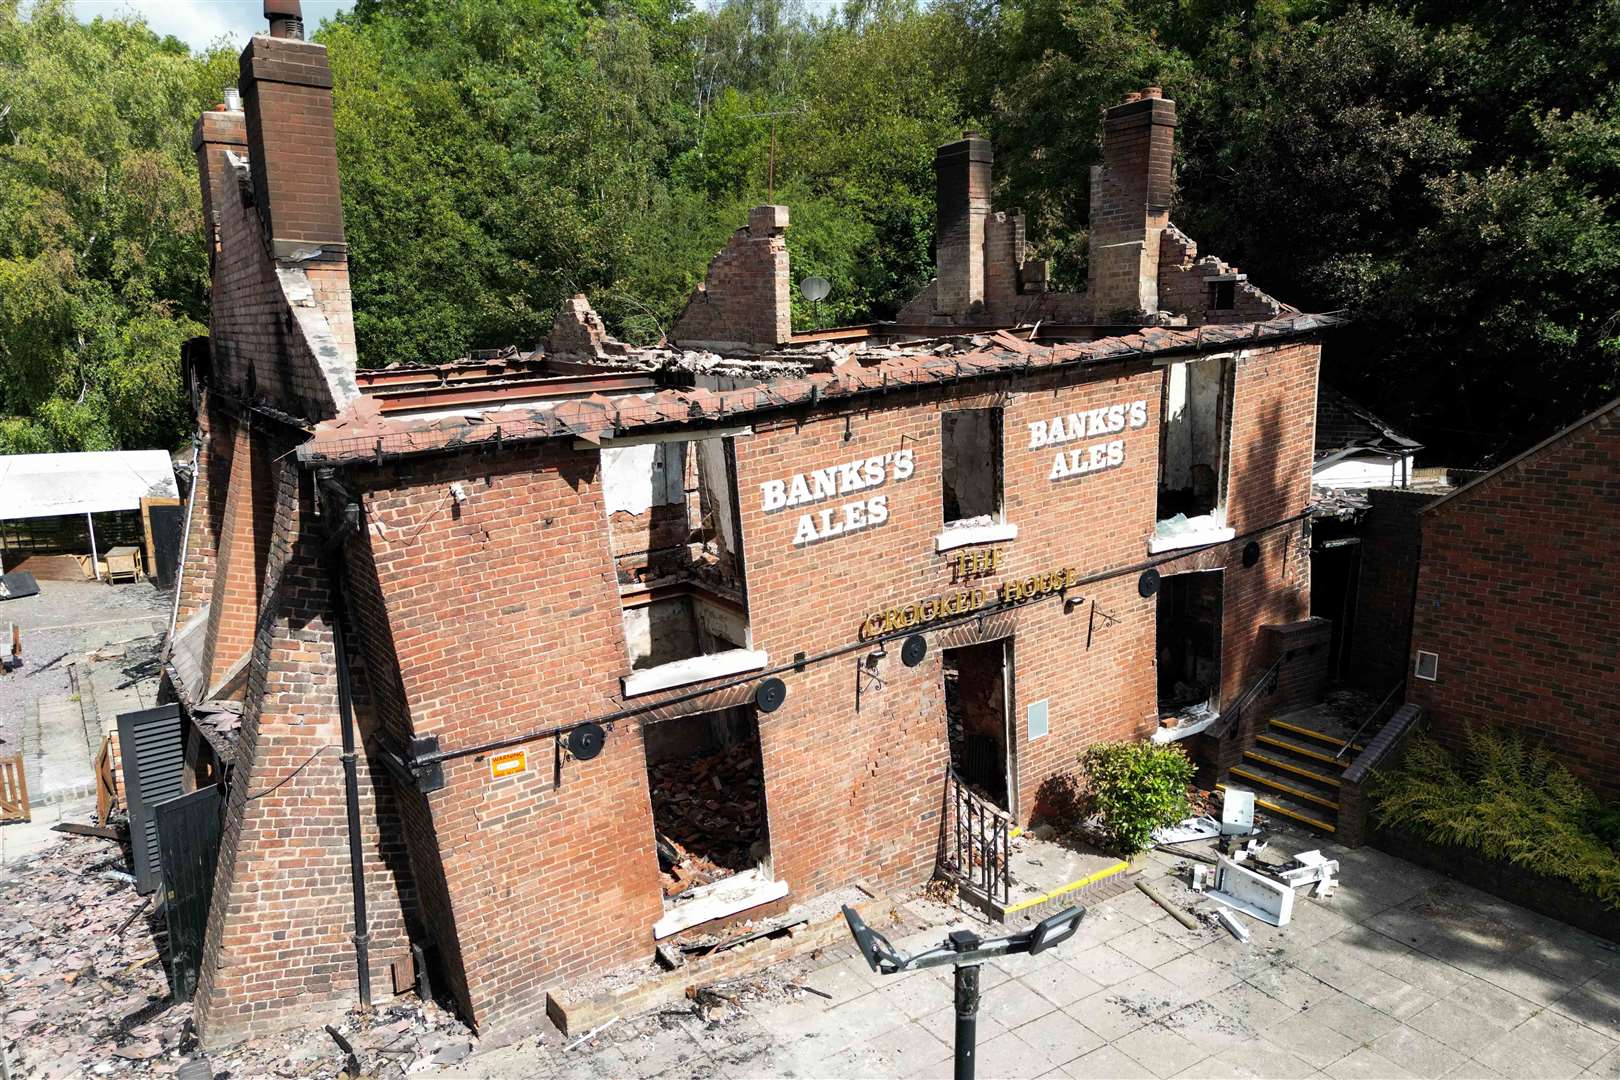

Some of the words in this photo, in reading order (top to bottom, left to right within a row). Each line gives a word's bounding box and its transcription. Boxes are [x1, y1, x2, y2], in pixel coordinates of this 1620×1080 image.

[1028, 400, 1147, 449] BANKS'S
[760, 449, 915, 512] BANKS'S
[1049, 440, 1124, 480] ALES
[792, 495, 888, 545] ALES
[955, 547, 1004, 577] THE
[863, 589, 986, 637] CROOKED
[1004, 568, 1077, 603] HOUSE
[492, 751, 524, 762] WARNING
